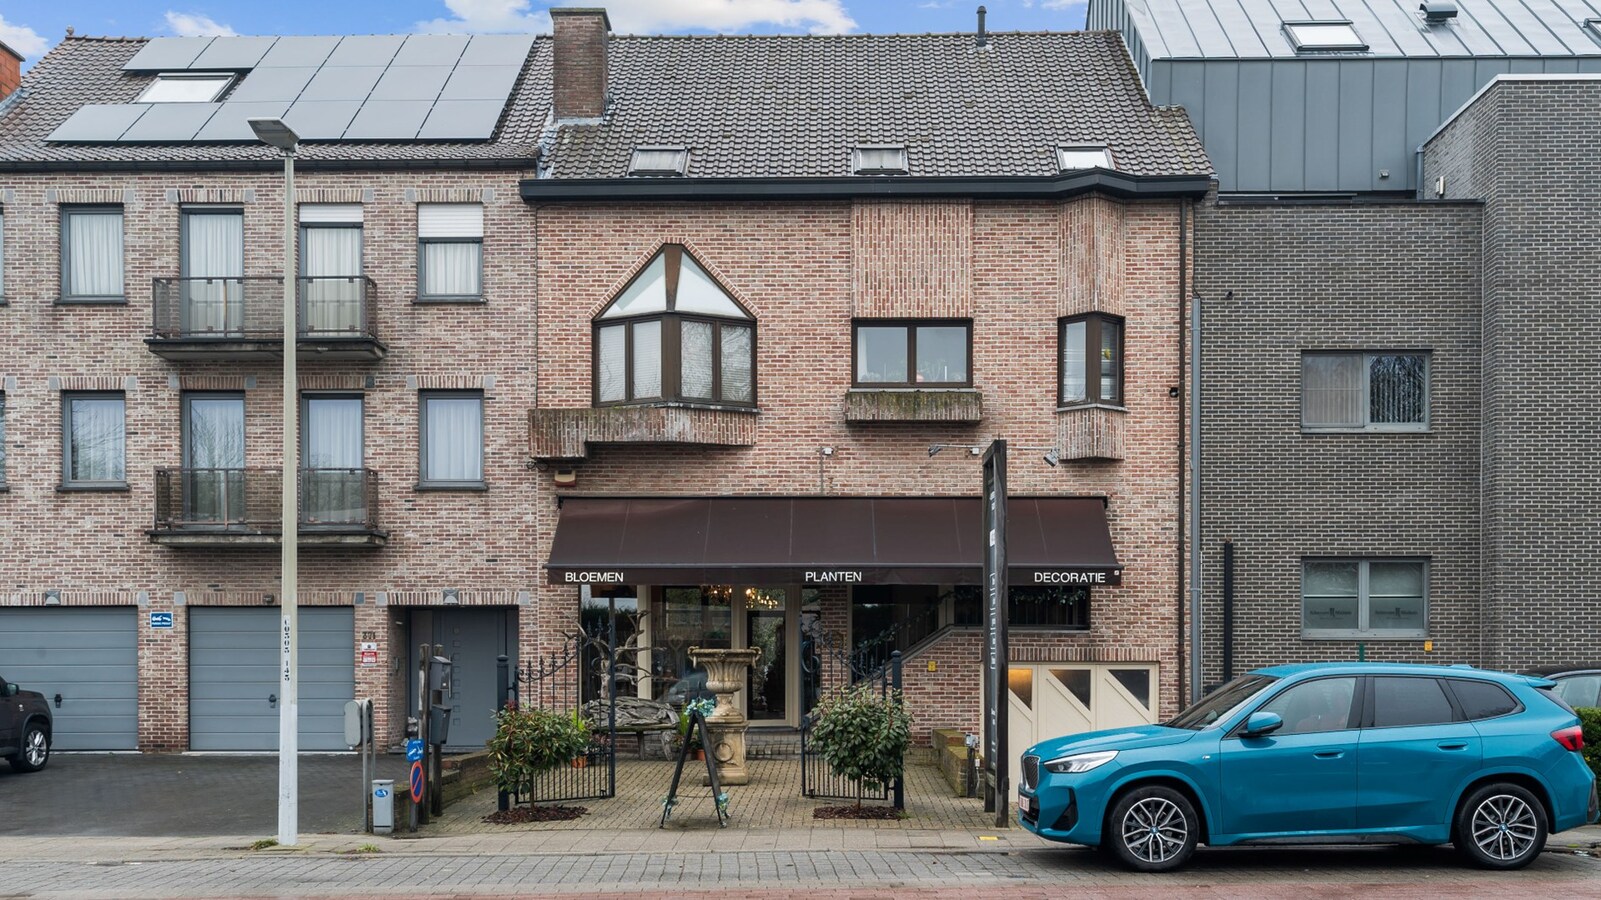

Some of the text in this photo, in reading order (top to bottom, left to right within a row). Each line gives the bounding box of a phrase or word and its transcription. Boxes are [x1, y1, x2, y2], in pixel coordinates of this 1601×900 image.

[565, 571, 1106, 583] BLOEMEN PLANTEN DECORATIE
